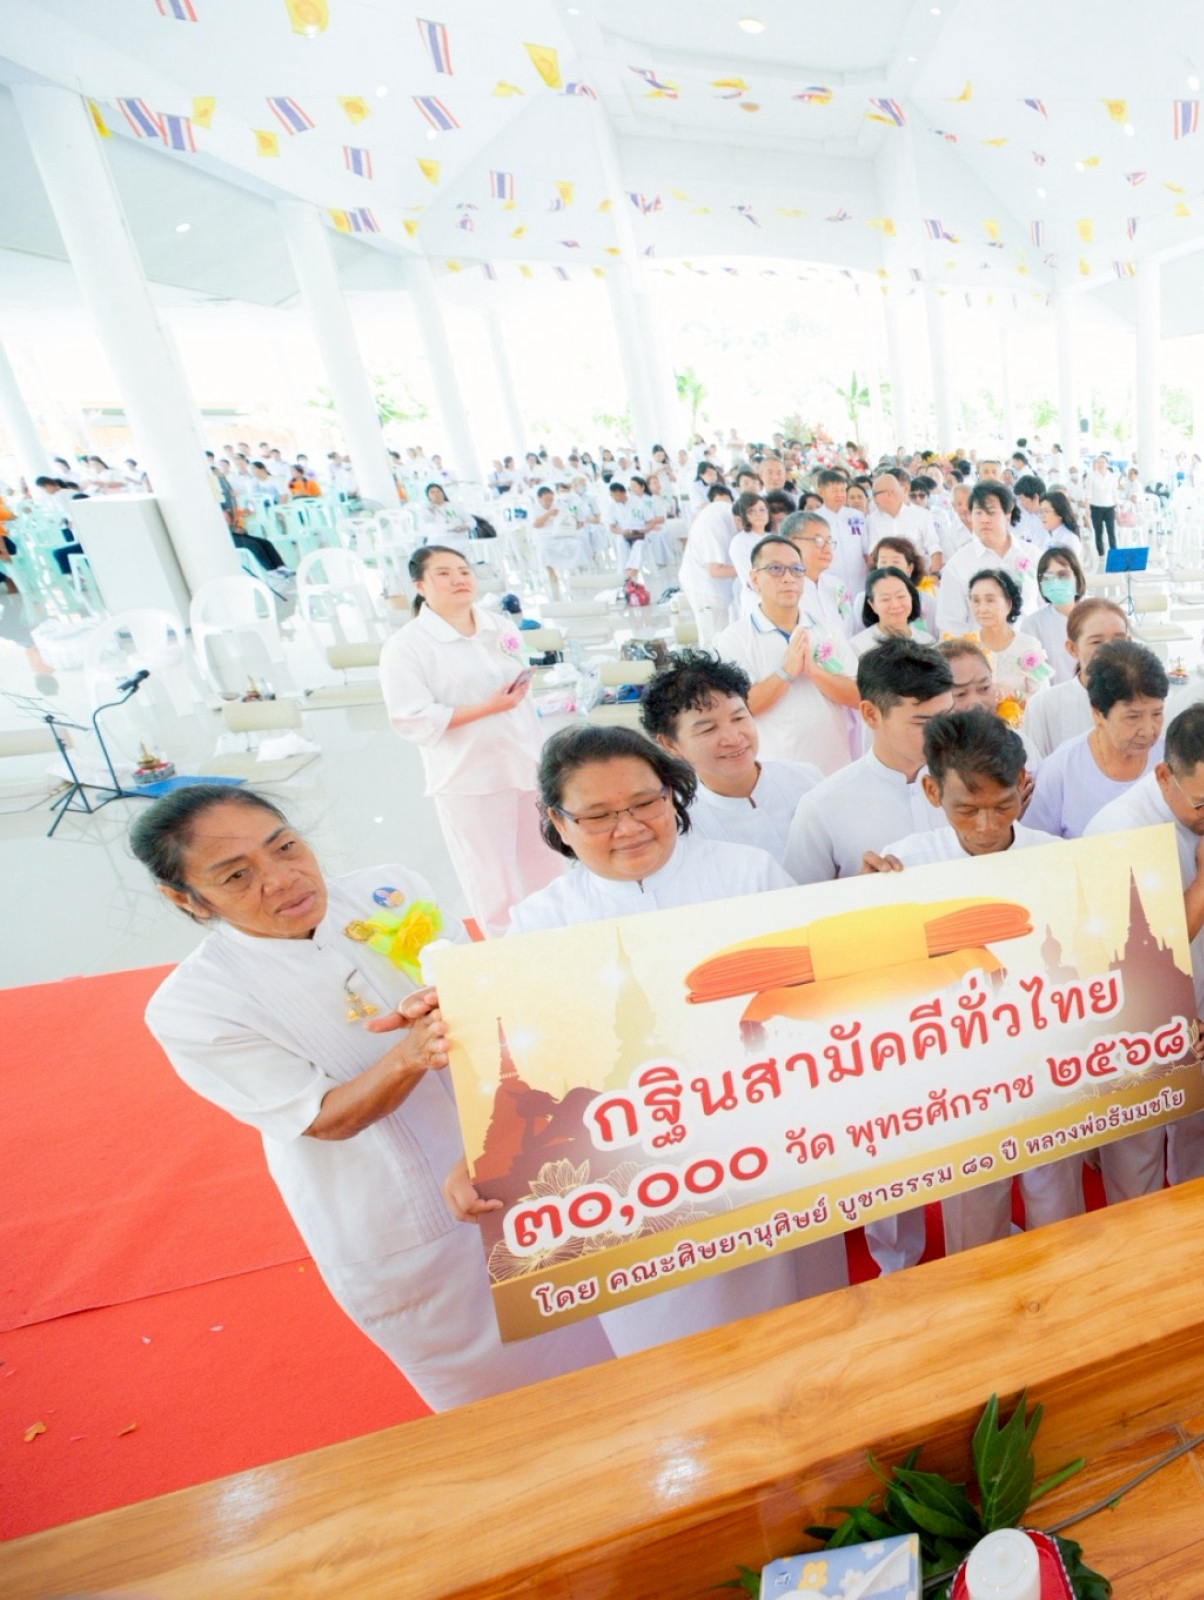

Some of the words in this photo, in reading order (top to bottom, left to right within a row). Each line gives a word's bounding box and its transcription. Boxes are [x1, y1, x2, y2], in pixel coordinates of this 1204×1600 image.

[513, 1146, 769, 1248] ๓๐,๐๐๐
[785, 1127, 835, 1164] วัด
[846, 1073, 1035, 1157] พุทธศักราช
[1046, 1022, 1186, 1088] ๒๕๖๘
[594, 975, 1119, 1149] กฐินสามัคคีทั่วไทย
[536, 1279, 597, 1314] โดย
[610, 1197, 829, 1291] คณะศิษยานุศิษย์
[838, 1166, 952, 1220] บูชาธรรม
[961, 1154, 994, 1176] ๘๑
[1001, 1139, 1018, 1162] ปี
[1025, 1089, 1185, 1154] หลวงพ่อธัมมชโย
